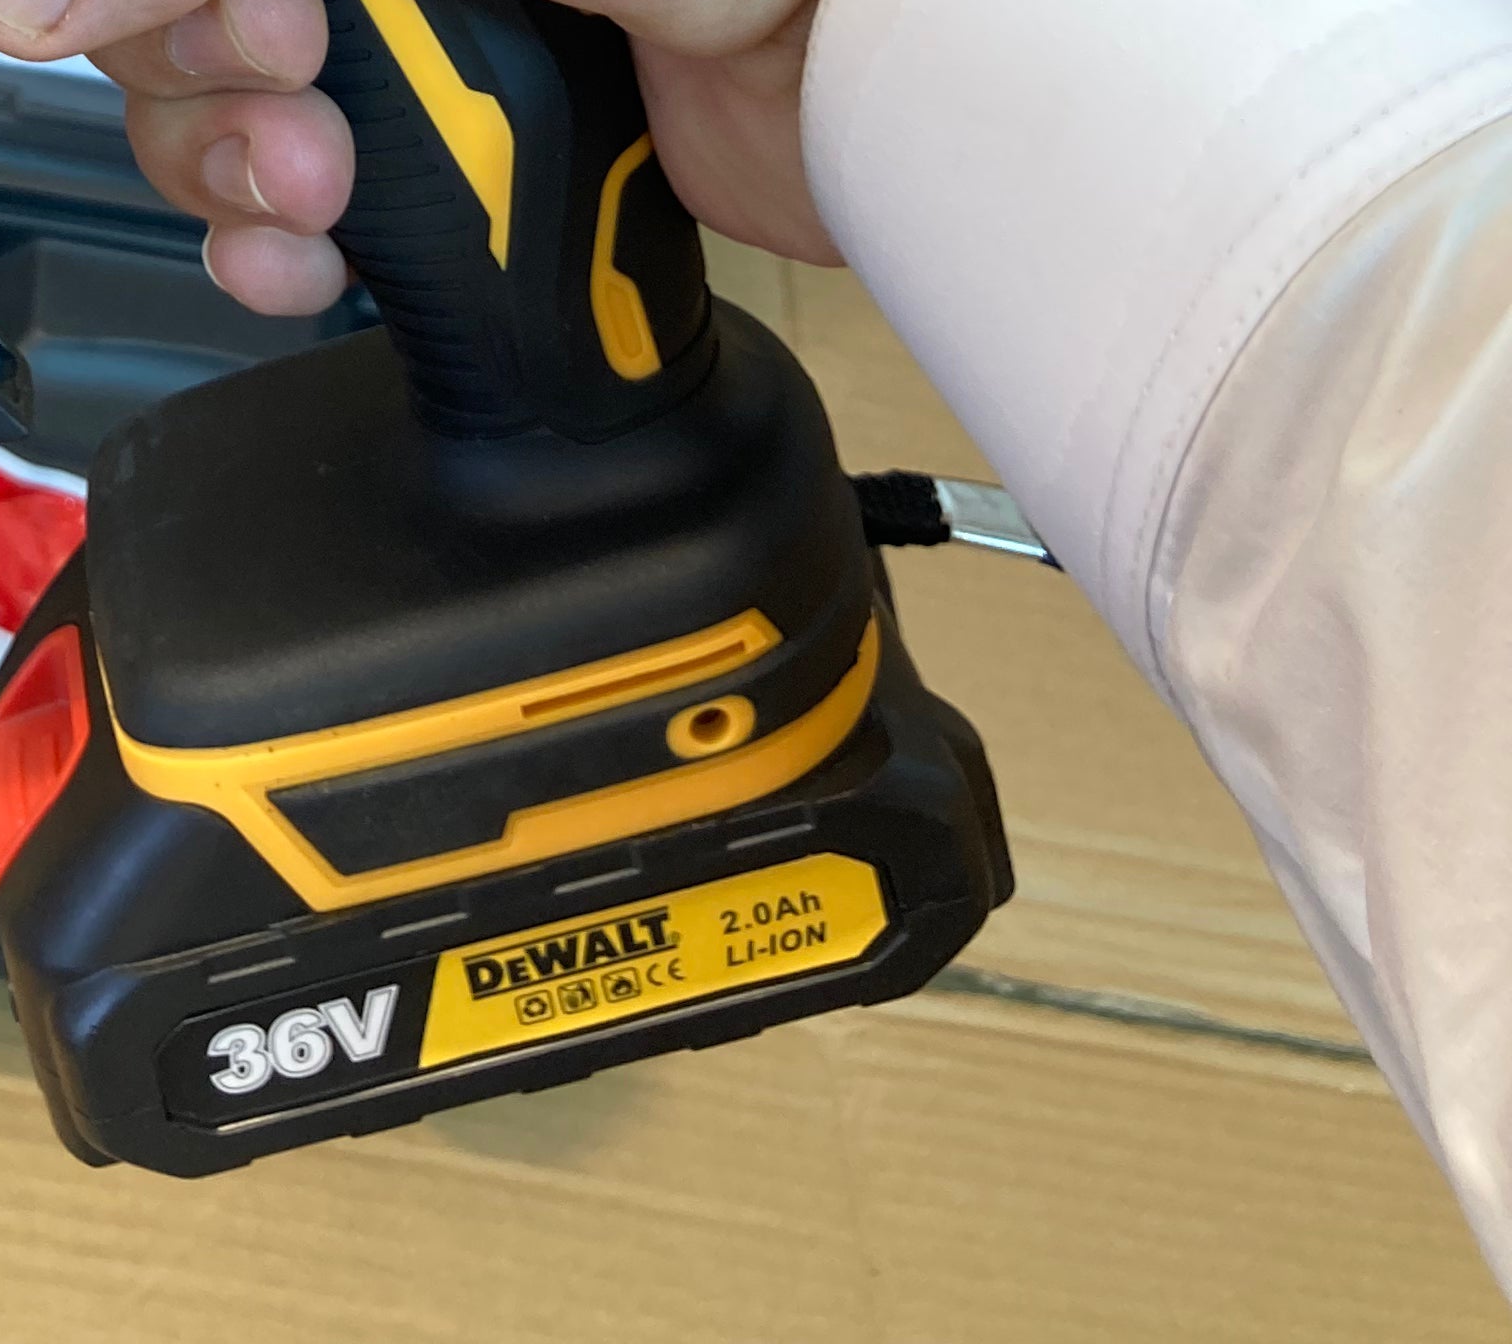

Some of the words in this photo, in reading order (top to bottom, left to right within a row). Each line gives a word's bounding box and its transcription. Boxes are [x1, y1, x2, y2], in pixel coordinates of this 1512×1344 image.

[720, 891, 822, 934] 2.0Ah
[726, 921, 826, 967] LI-ION
[466, 912, 670, 996] DEWALT
[207, 984, 400, 1094] 36V
